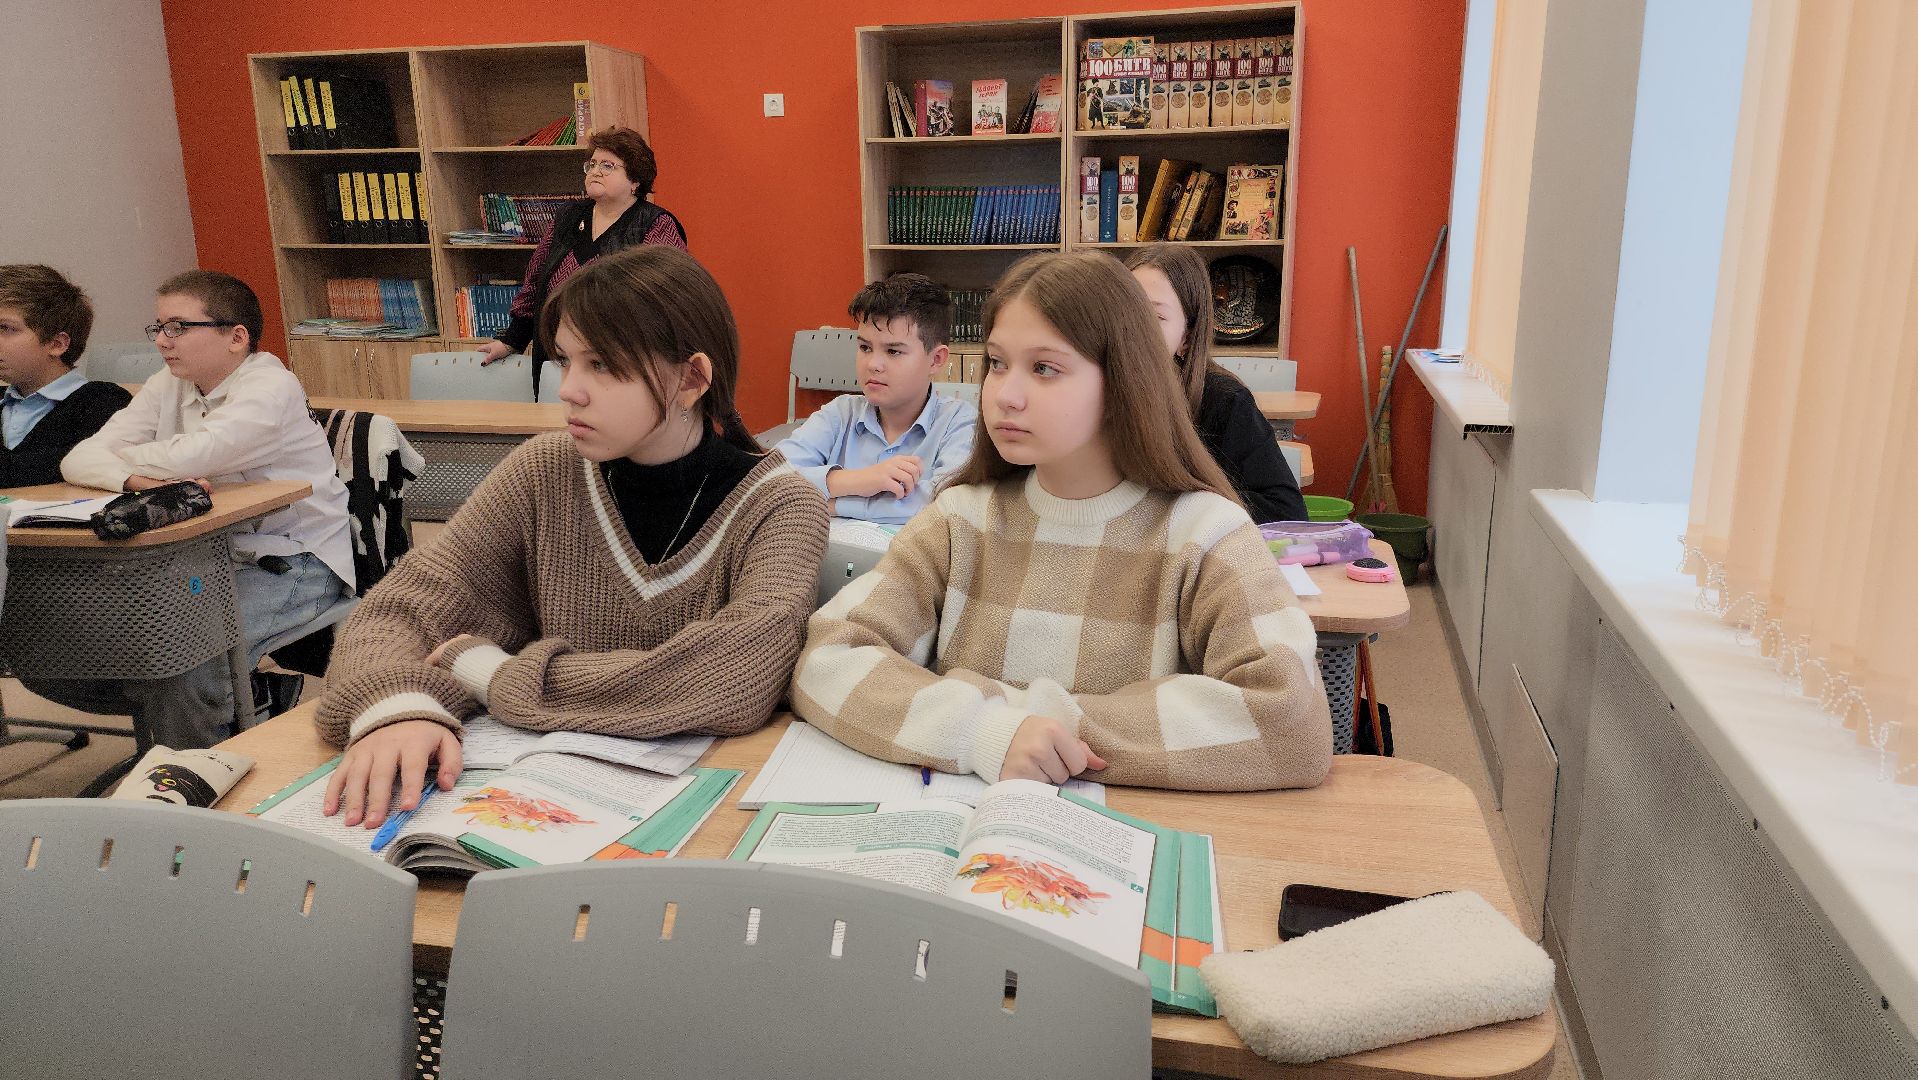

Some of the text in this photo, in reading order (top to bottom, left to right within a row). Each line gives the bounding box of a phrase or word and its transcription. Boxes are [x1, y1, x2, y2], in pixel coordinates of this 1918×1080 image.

[1216, 60, 1230, 70] 100
[1238, 60, 1251, 70] 100
[1258, 58, 1273, 68] 100
[1278, 56, 1292, 66] 100
[1089, 60, 1113, 77] 100
[1113, 58, 1151, 72] БИТВ
[1153, 64, 1166, 74] 100
[1172, 62, 1187, 72] 100
[1193, 62, 1207, 71] 100
[577, 100, 585, 137] ИСТОРИЯ
[1122, 176, 1135, 186] 100
